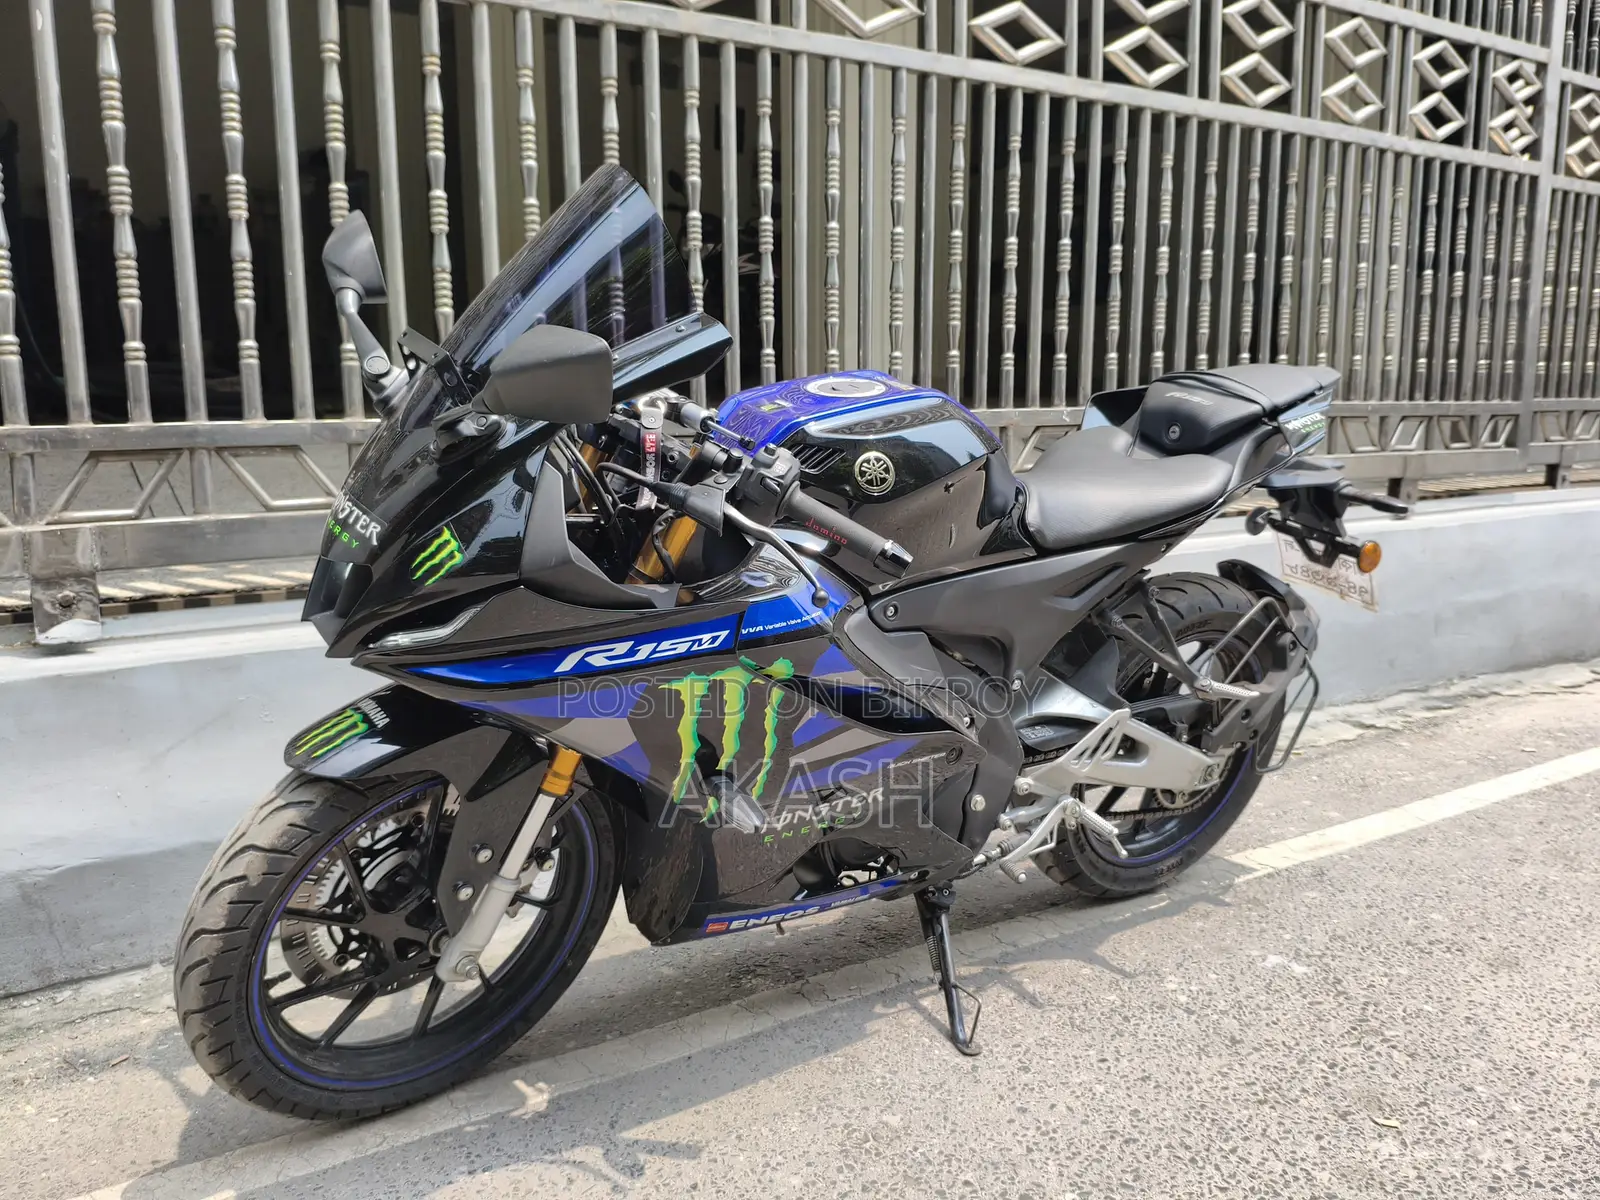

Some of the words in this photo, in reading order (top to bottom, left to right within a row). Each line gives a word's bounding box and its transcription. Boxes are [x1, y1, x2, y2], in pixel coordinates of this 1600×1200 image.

[804, 517, 848, 545] domino
[741, 625, 764, 635] VVA
[764, 621, 787, 631] Variable
[729, 905, 822, 930] ENEOS
